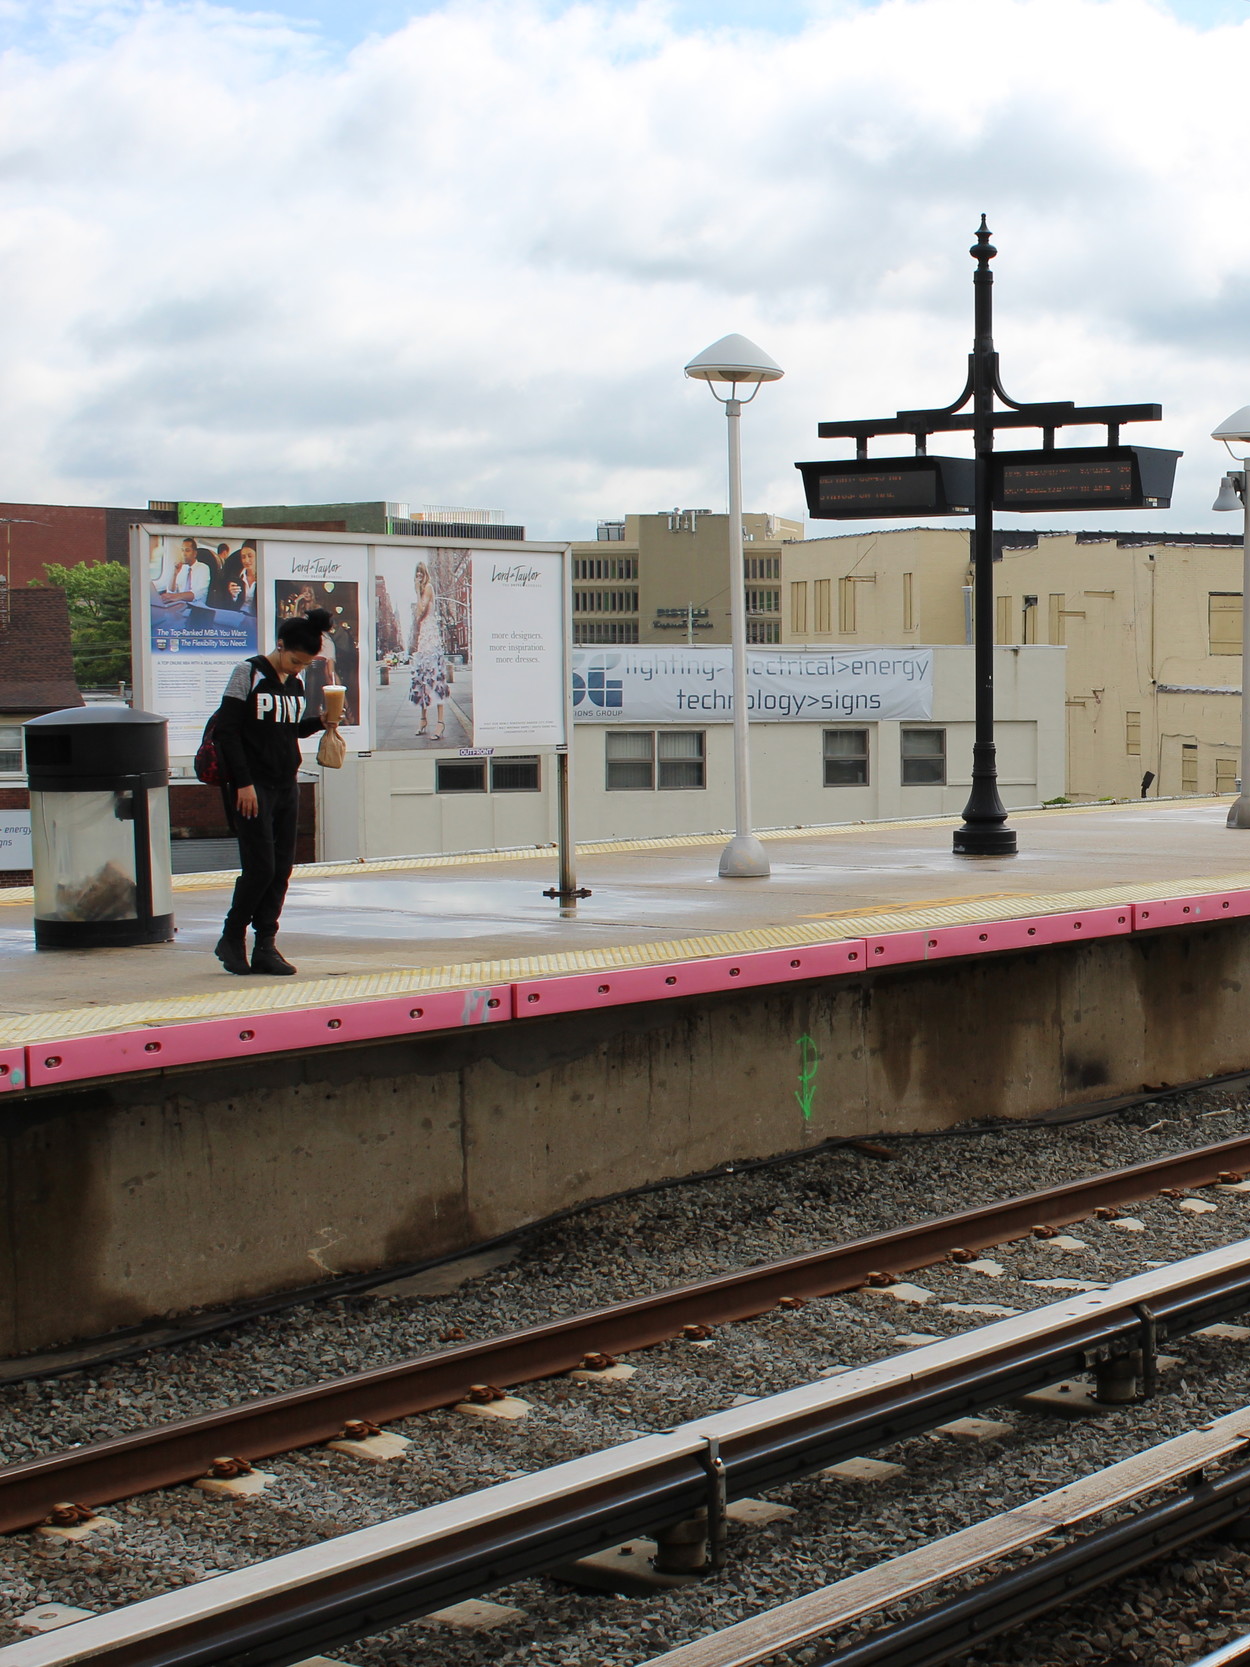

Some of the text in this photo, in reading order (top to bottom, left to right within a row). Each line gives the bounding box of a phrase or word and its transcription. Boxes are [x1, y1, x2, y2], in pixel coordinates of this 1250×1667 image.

[313, 557, 341, 578] Taylor
[514, 565, 541, 587] Taylor
[157, 628, 169, 636] The
[170, 629, 203, 637] Top-Ranked
[204, 629, 218, 637] MBA
[181, 639, 191, 647] The
[192, 640, 218, 648] Flexibility
[460, 748, 493, 756] OUTFRONT
